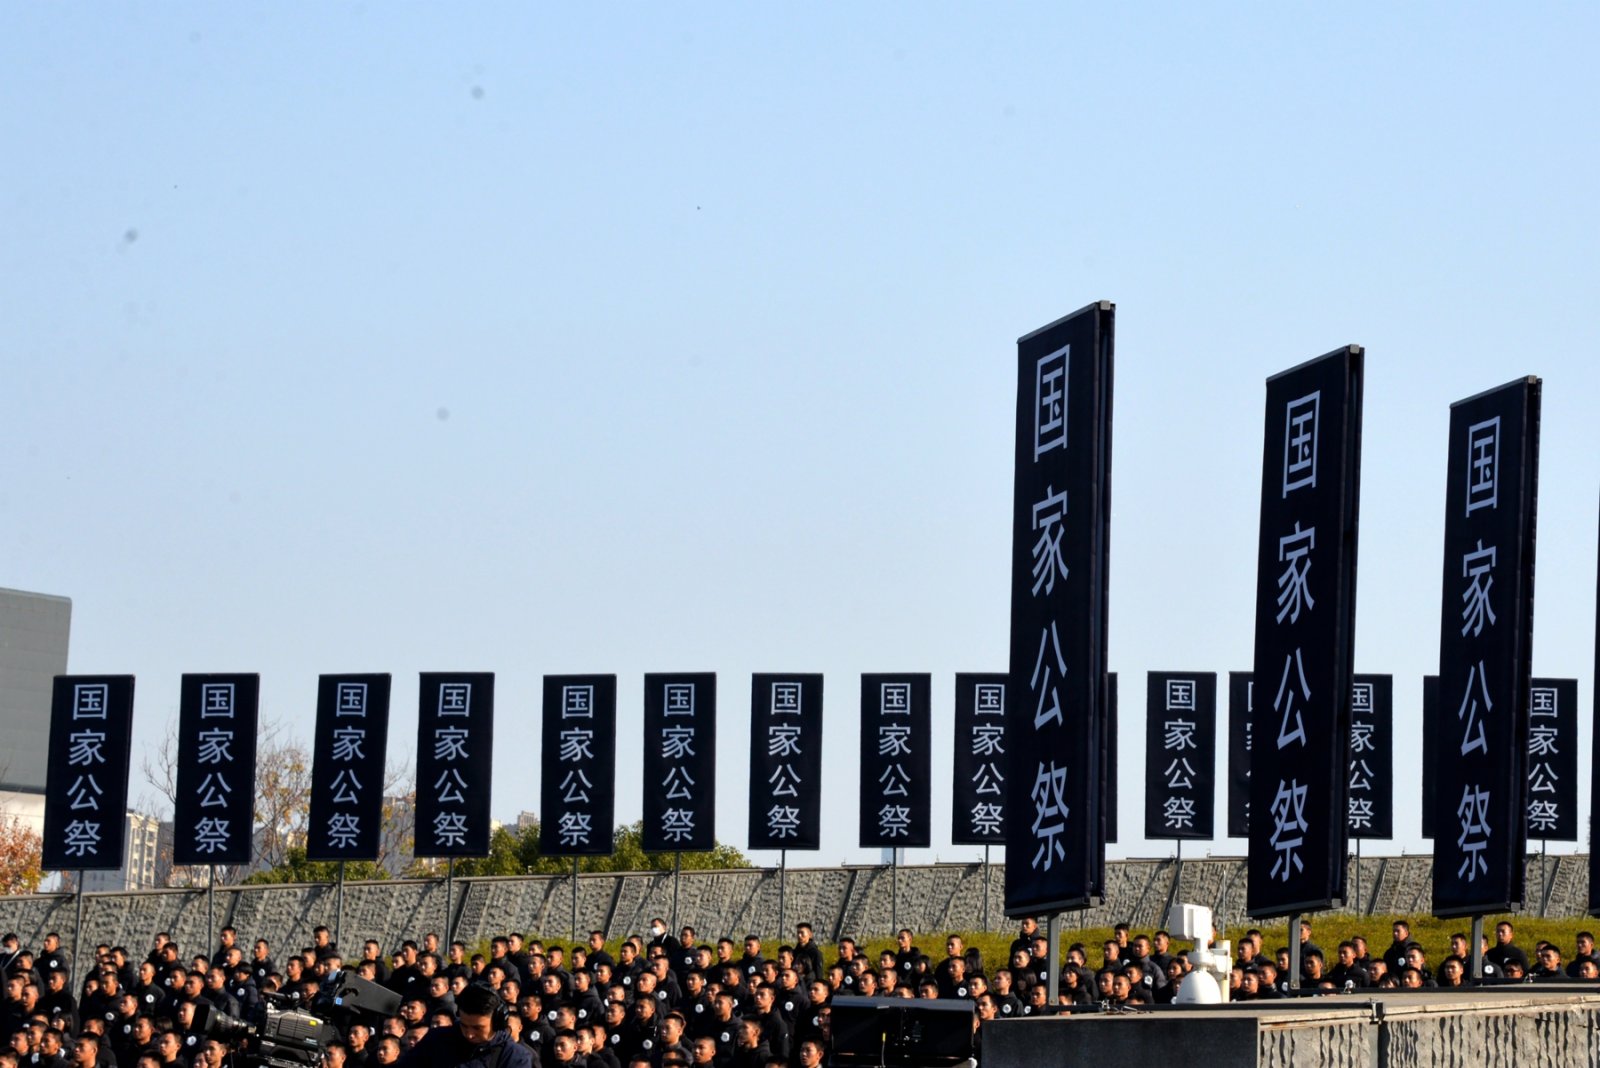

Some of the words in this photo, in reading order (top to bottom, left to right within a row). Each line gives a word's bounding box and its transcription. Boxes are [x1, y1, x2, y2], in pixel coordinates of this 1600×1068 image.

[1030, 343, 1070, 872] 国家公祭
[1270, 390, 1321, 882] 国家公祭
[1456, 415, 1501, 882] 国家公祭
[64, 683, 109, 857] 国家公祭
[194, 683, 234, 854] 国家公祭
[327, 682, 368, 848] 国家公祭
[433, 683, 472, 847] 国家公祭
[558, 685, 594, 846] 国家公祭
[661, 683, 695, 842] 国家公祭
[767, 682, 802, 838] 国家公祭
[878, 682, 912, 838] 国家公祭
[970, 683, 1005, 835] 国家公祭
[1163, 679, 1197, 829] 国家公祭
[1527, 687, 1559, 831] 国家公祭
